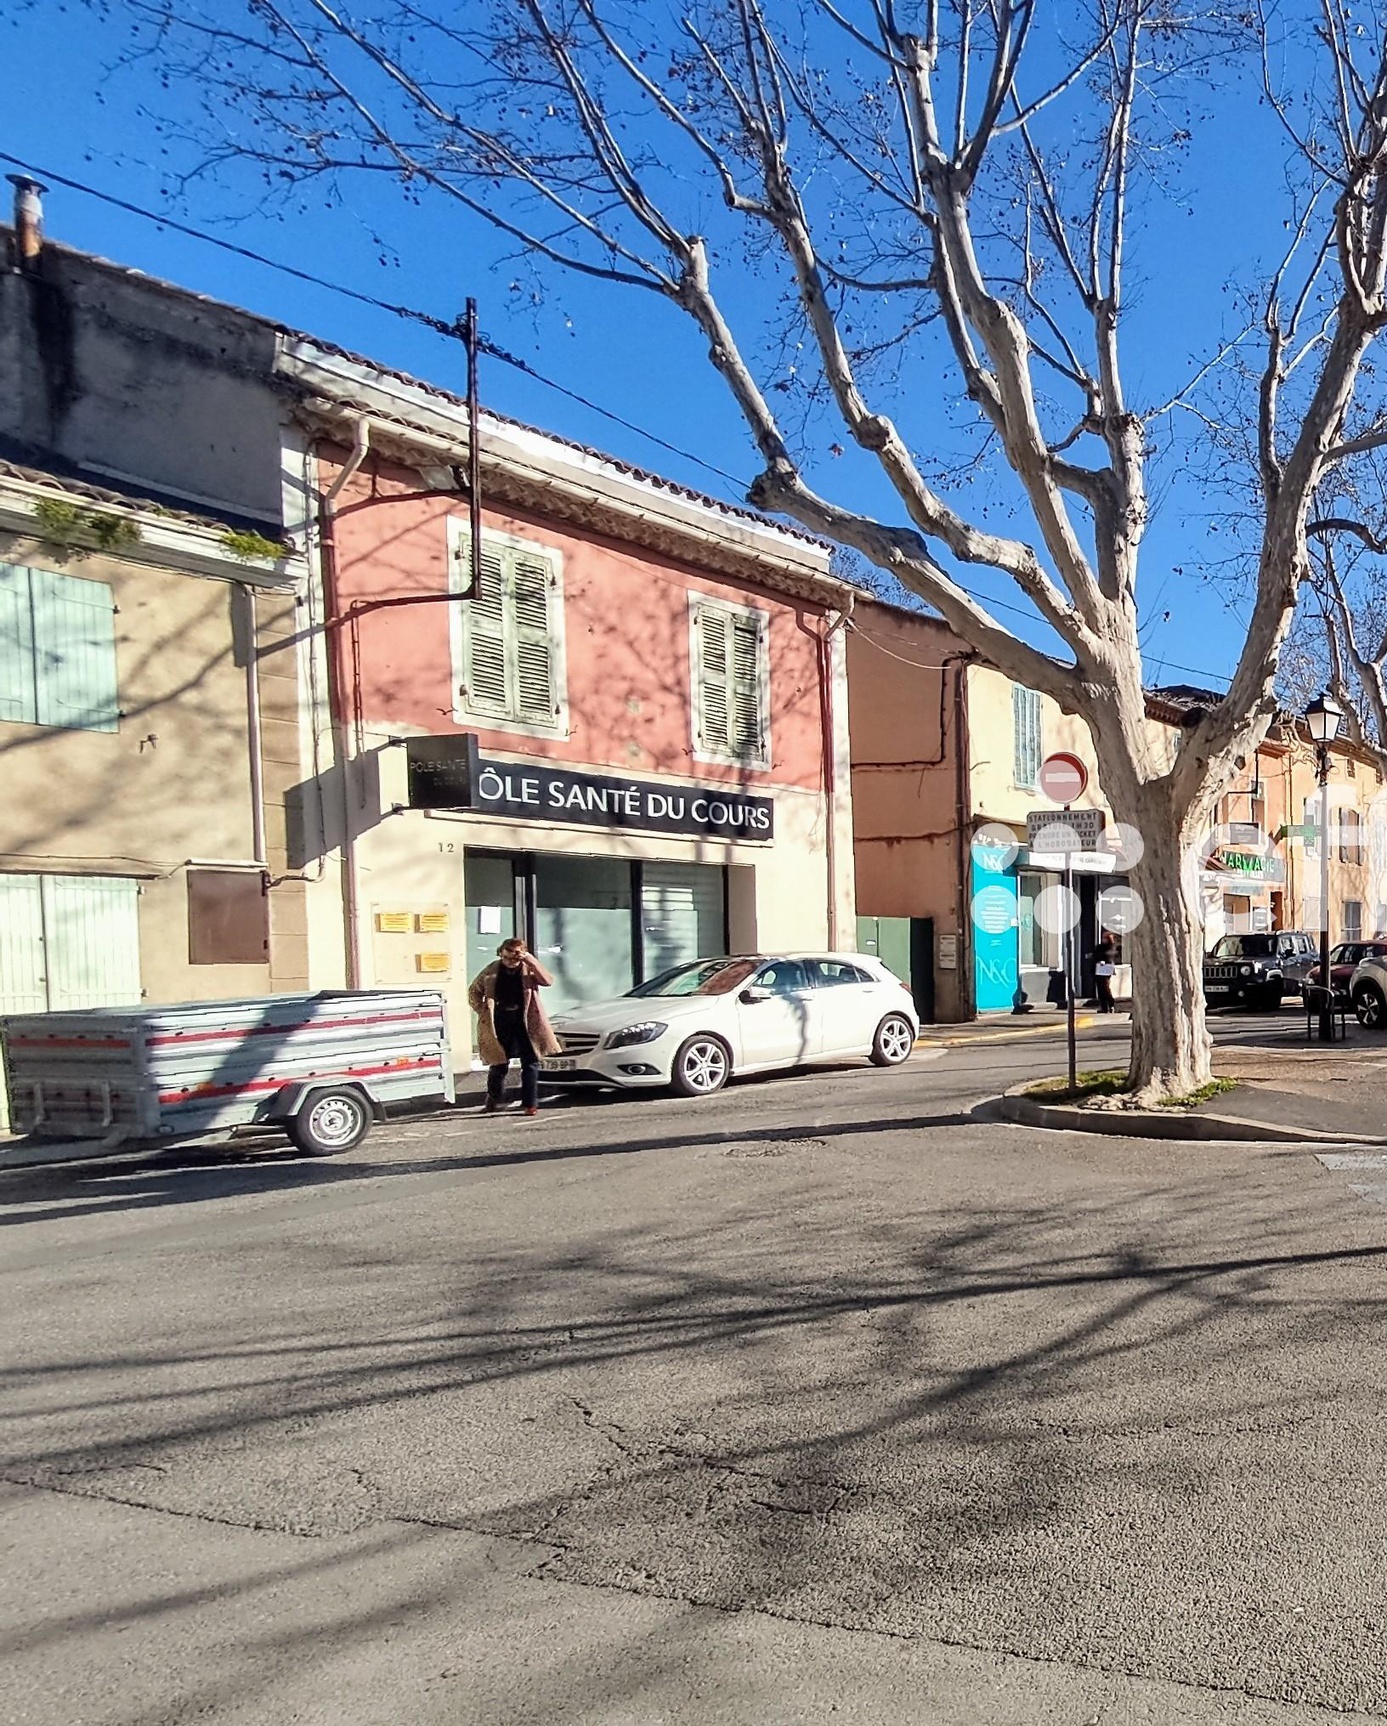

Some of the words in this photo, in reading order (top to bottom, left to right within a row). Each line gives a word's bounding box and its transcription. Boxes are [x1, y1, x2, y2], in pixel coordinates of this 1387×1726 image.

[478, 767, 540, 805] ÔLE
[548, 780, 640, 816] SANTÉ
[648, 794, 685, 820] DU
[691, 800, 771, 830] COURS
[1028, 812, 1097, 822] STATIONNEMENT
[438, 842, 454, 853] 12
